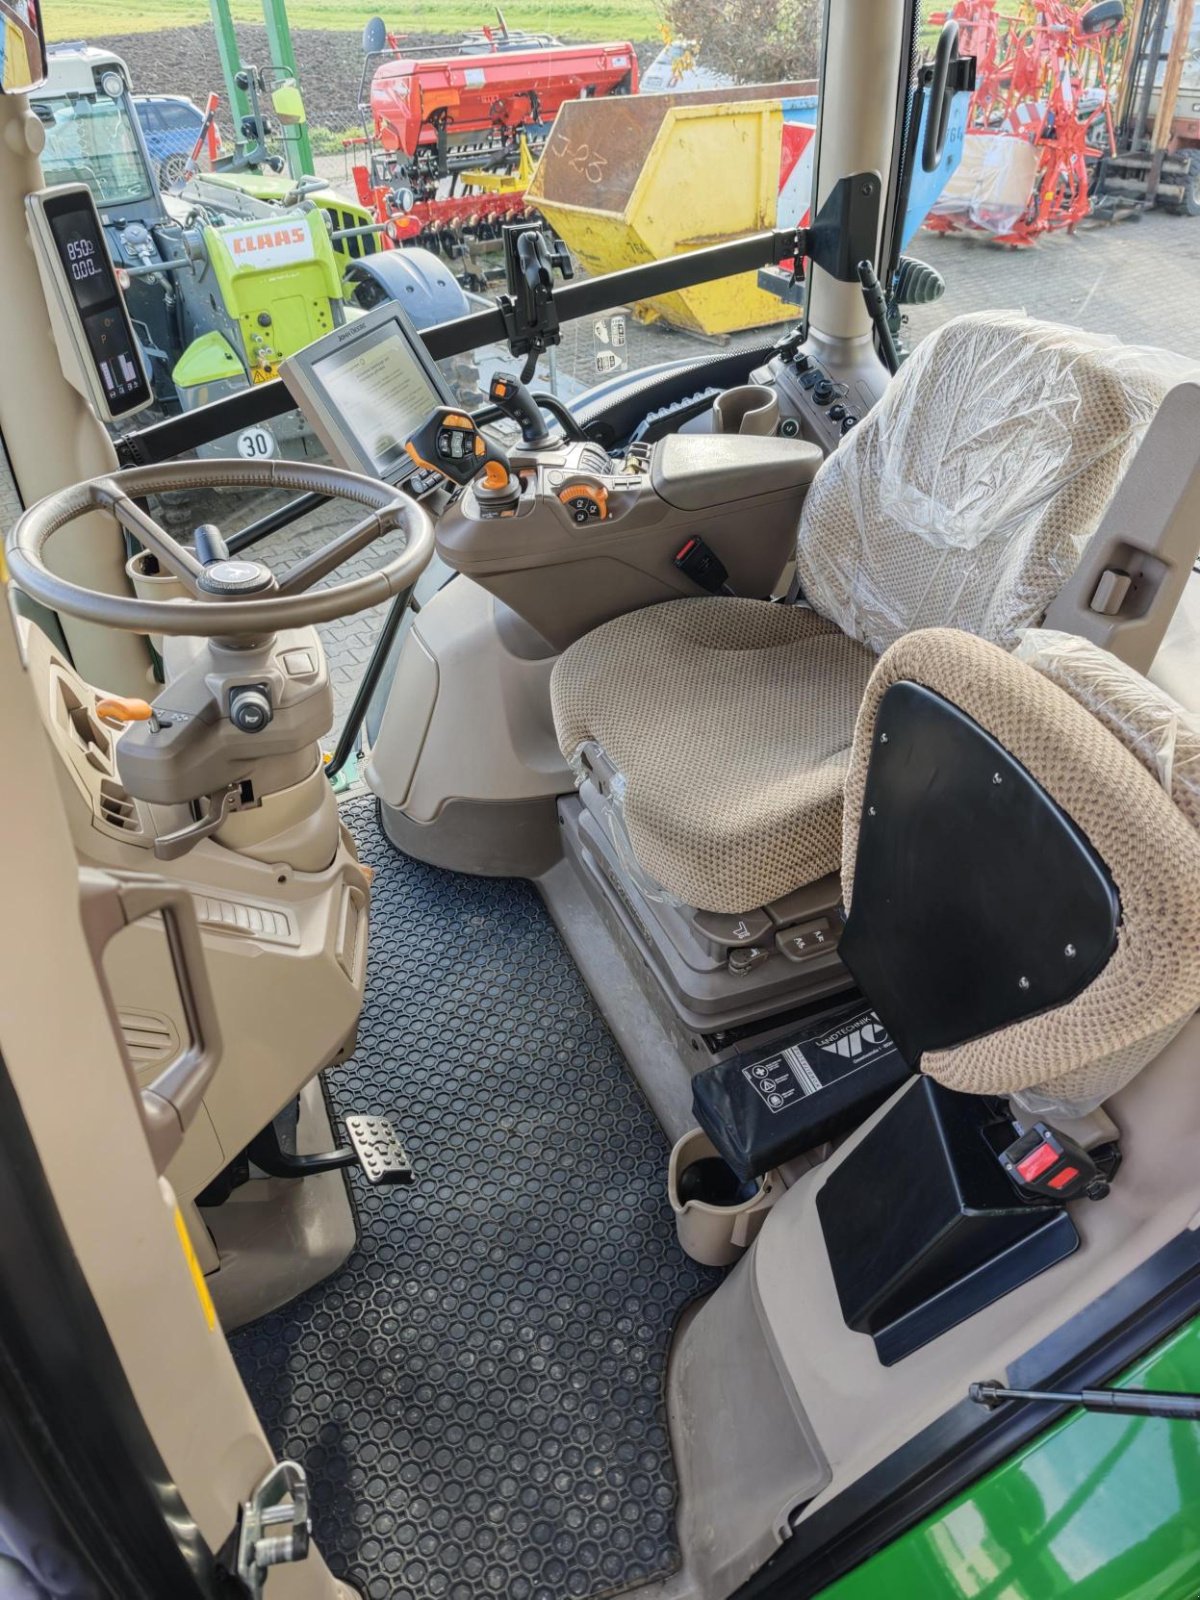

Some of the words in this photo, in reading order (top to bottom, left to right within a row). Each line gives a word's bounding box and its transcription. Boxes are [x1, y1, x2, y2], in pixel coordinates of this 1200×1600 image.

[232, 227, 305, 255] CLAAS
[243, 433, 268, 457] 30
[815, 1015, 872, 1048] LANDTECHNIK
